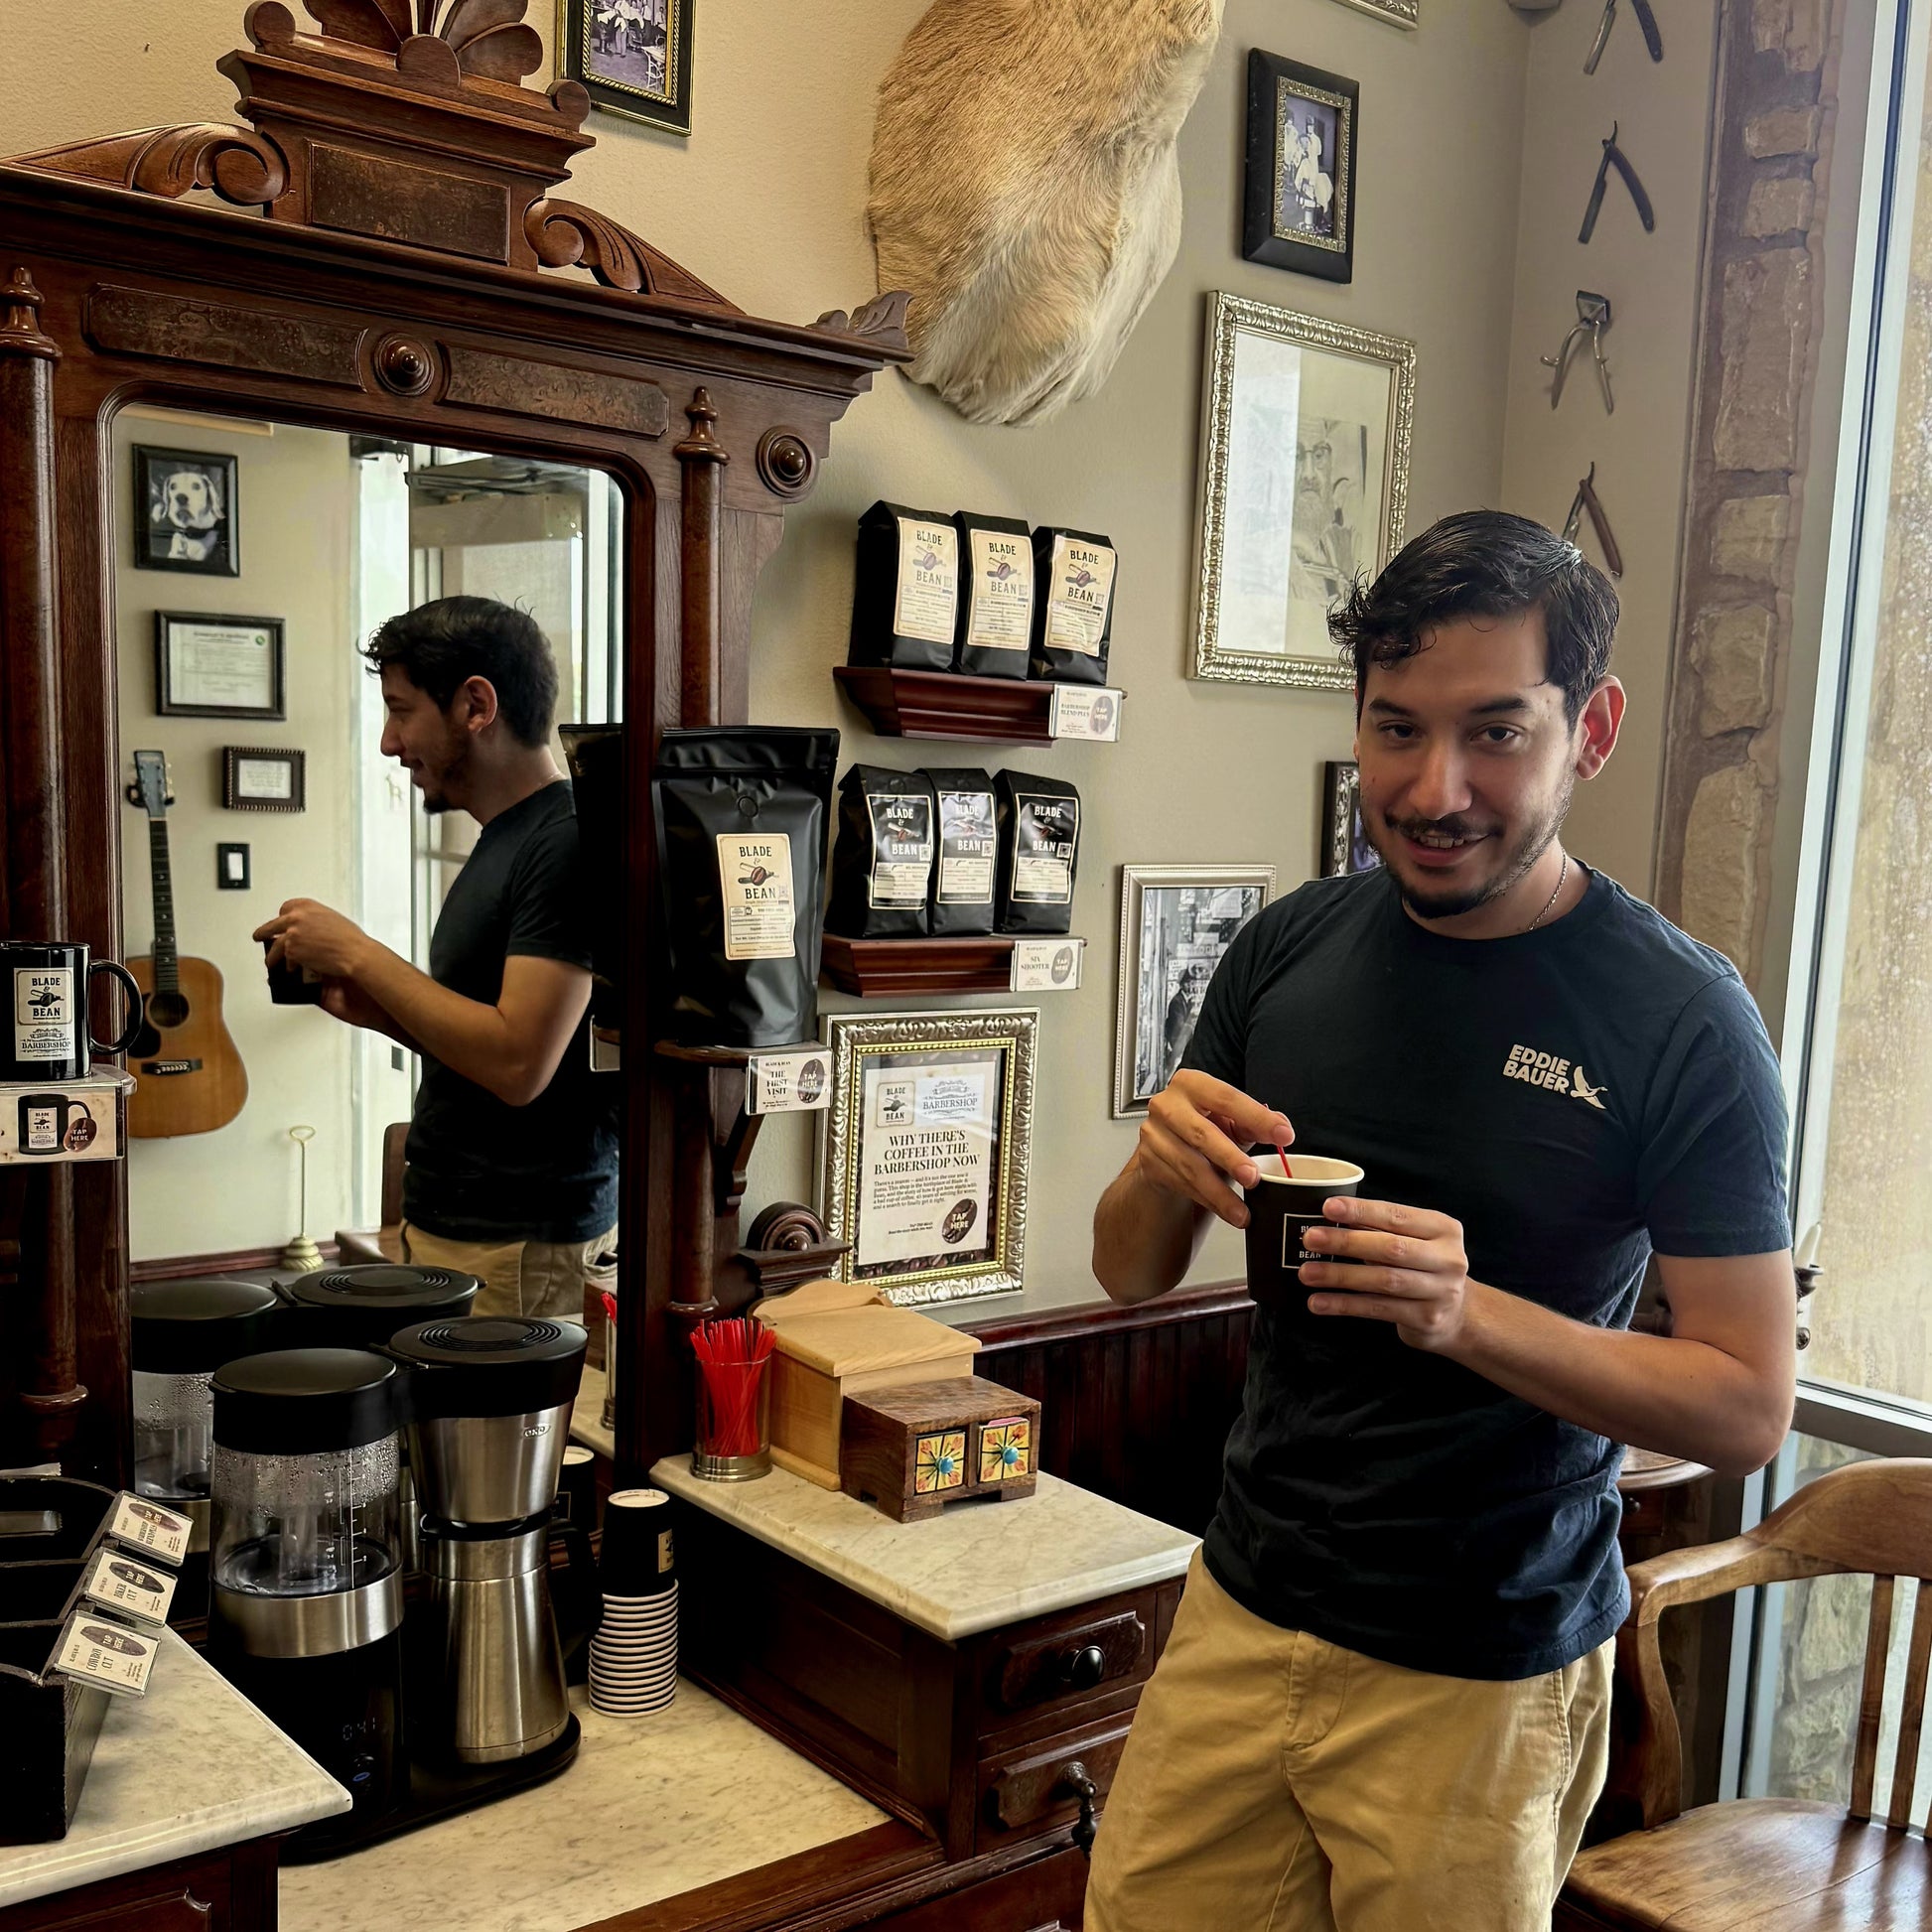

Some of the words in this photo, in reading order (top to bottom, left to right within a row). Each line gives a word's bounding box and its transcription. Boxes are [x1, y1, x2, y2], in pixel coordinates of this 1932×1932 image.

[917, 530, 942, 545] BLADE
[989, 542, 1016, 555] BLADE
[1070, 550, 1099, 564] BLADE
[916, 570, 941, 585] BEAN
[991, 582, 1017, 595] BEAN
[1068, 587, 1094, 602] BEAN
[886, 807, 913, 819] BLADE
[1035, 805, 1062, 818] BLADE
[739, 846, 772, 857] BLADE
[892, 844, 917, 855] BEAN
[957, 840, 981, 851] BEAN
[1033, 840, 1056, 852] BEAN
[746, 889, 775, 899] BEAN
[33, 1008, 60, 1017] BEAN
[1509, 1043, 1571, 1076] EDDIE
[1503, 1060, 1570, 1094] BAUER
[923, 1098, 977, 1110] BARBERSHOP
[890, 1134, 916, 1146] WHY
[919, 1130, 966, 1144] THERE'S
[885, 1147, 928, 1161] COFFEE
[931, 1145, 944, 1156] IN
[946, 1143, 969, 1155] THE
[875, 1157, 950, 1174] BARBERSHOP
[953, 1154, 980, 1168] NOW
[127, 1589, 138, 1600] CUT
[103, 1634, 113, 1645] TAP
[113, 1637, 124, 1649] HERE
[86, 1648, 102, 1671] COWBOY
[101, 1656, 113, 1669] CUT
